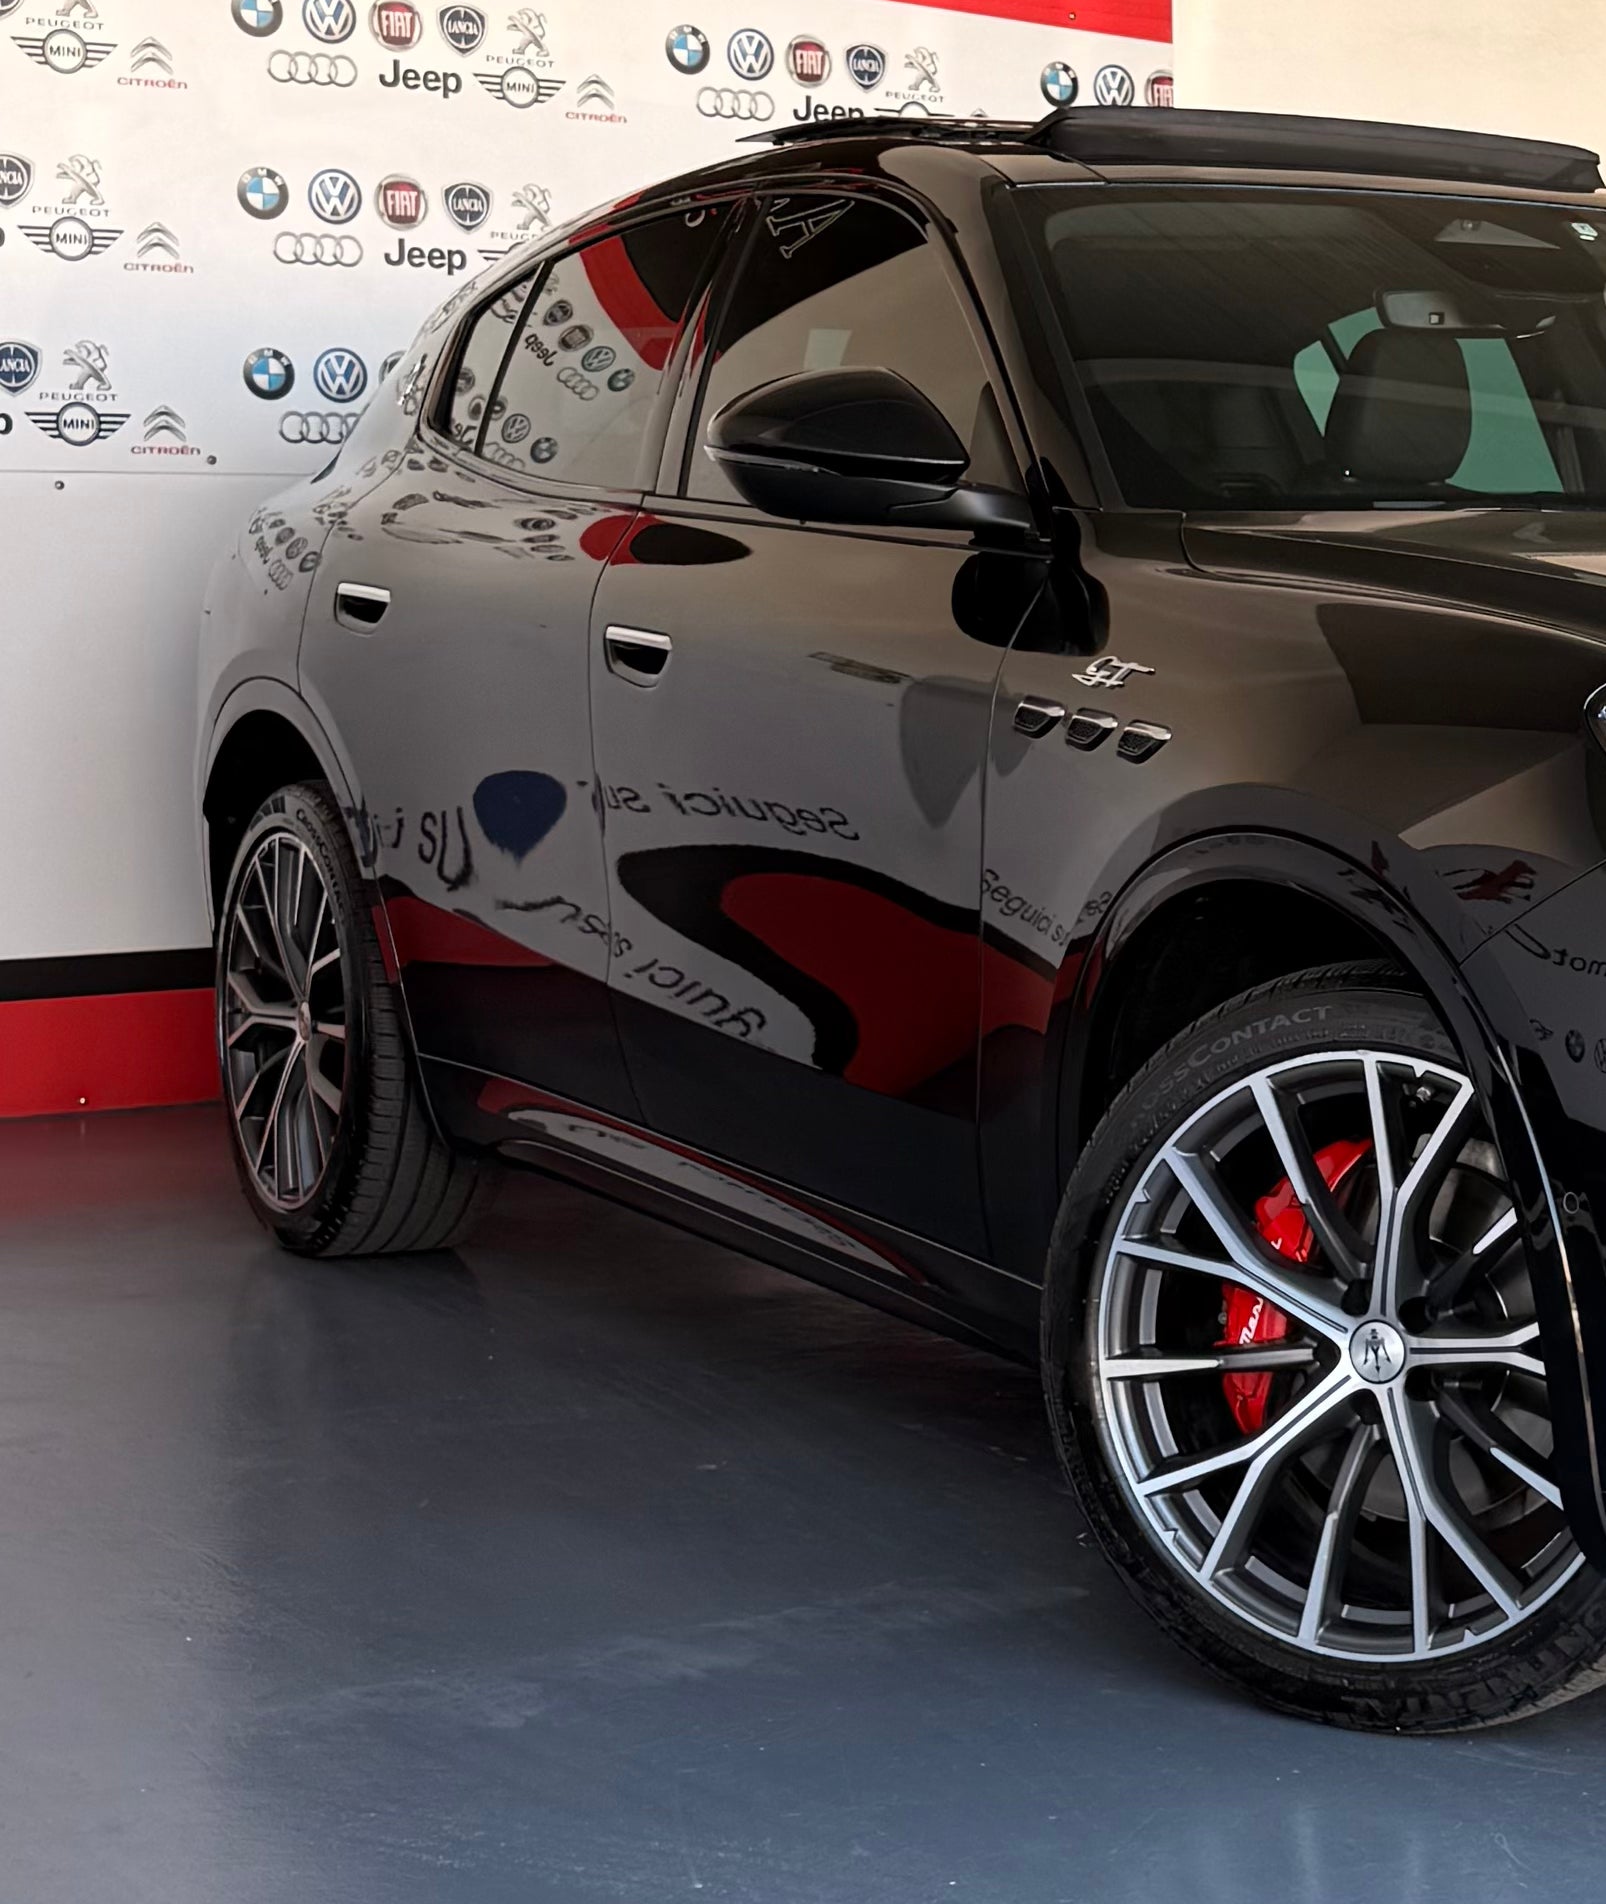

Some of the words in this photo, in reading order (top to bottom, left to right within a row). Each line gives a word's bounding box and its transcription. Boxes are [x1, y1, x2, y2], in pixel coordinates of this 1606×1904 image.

[25, 16, 105, 30] PEUGEOT
[380, 9, 413, 38] FIAT
[49, 45, 81, 58] MINI
[485, 54, 555, 68] PEUGEOT
[795, 50, 825, 76] FIAT
[378, 58, 463, 99] Jeep
[506, 81, 535, 94] MINI
[386, 189, 418, 217] FIAT
[32, 205, 110, 217] PEUGEOT
[55, 233, 88, 245] MINI
[384, 238, 467, 275] Jeep
[0, 357, 31, 374] ANCIA
[39, 391, 118, 402] PEUGEOT
[63, 418, 95, 430] MINI
